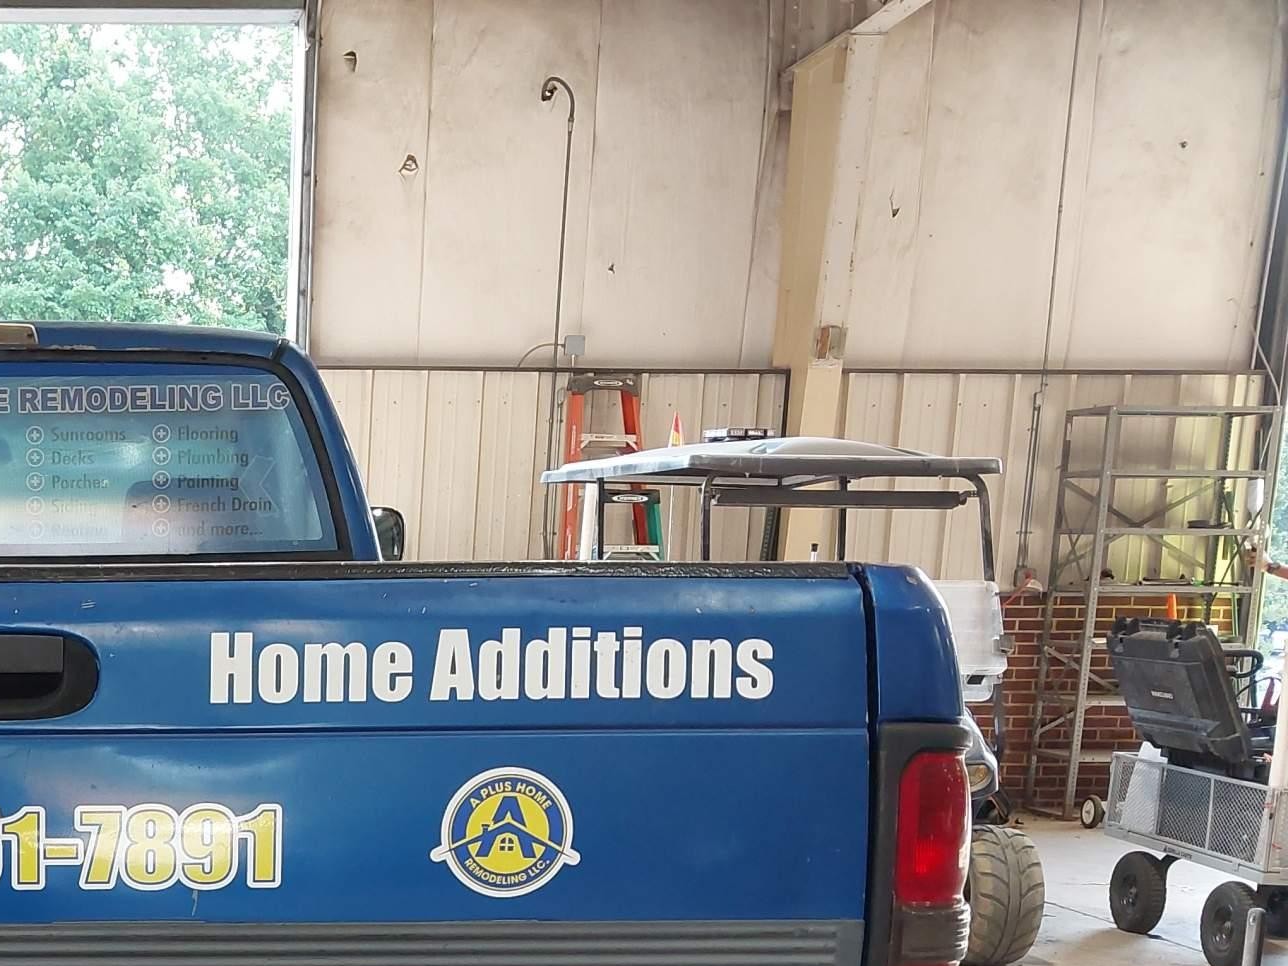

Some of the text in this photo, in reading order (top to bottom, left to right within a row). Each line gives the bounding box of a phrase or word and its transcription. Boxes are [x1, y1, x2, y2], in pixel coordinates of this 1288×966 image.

[18, 384, 223, 413] REMODELING
[231, 383, 291, 411] LLC
[51, 427, 126, 441] Sunrooms
[178, 425, 239, 443] Flooring
[51, 450, 95, 466] Decks
[178, 448, 249, 467] Plumbing
[52, 472, 108, 489] Porches
[178, 474, 239, 491] Painting
[178, 496, 272, 512] French Drain
[177, 521, 205, 536] and
[210, 626, 774, 704] Home Additions
[469, 781, 552, 810] A PLUS HOME
[464, 858, 527, 885] REMODELING
